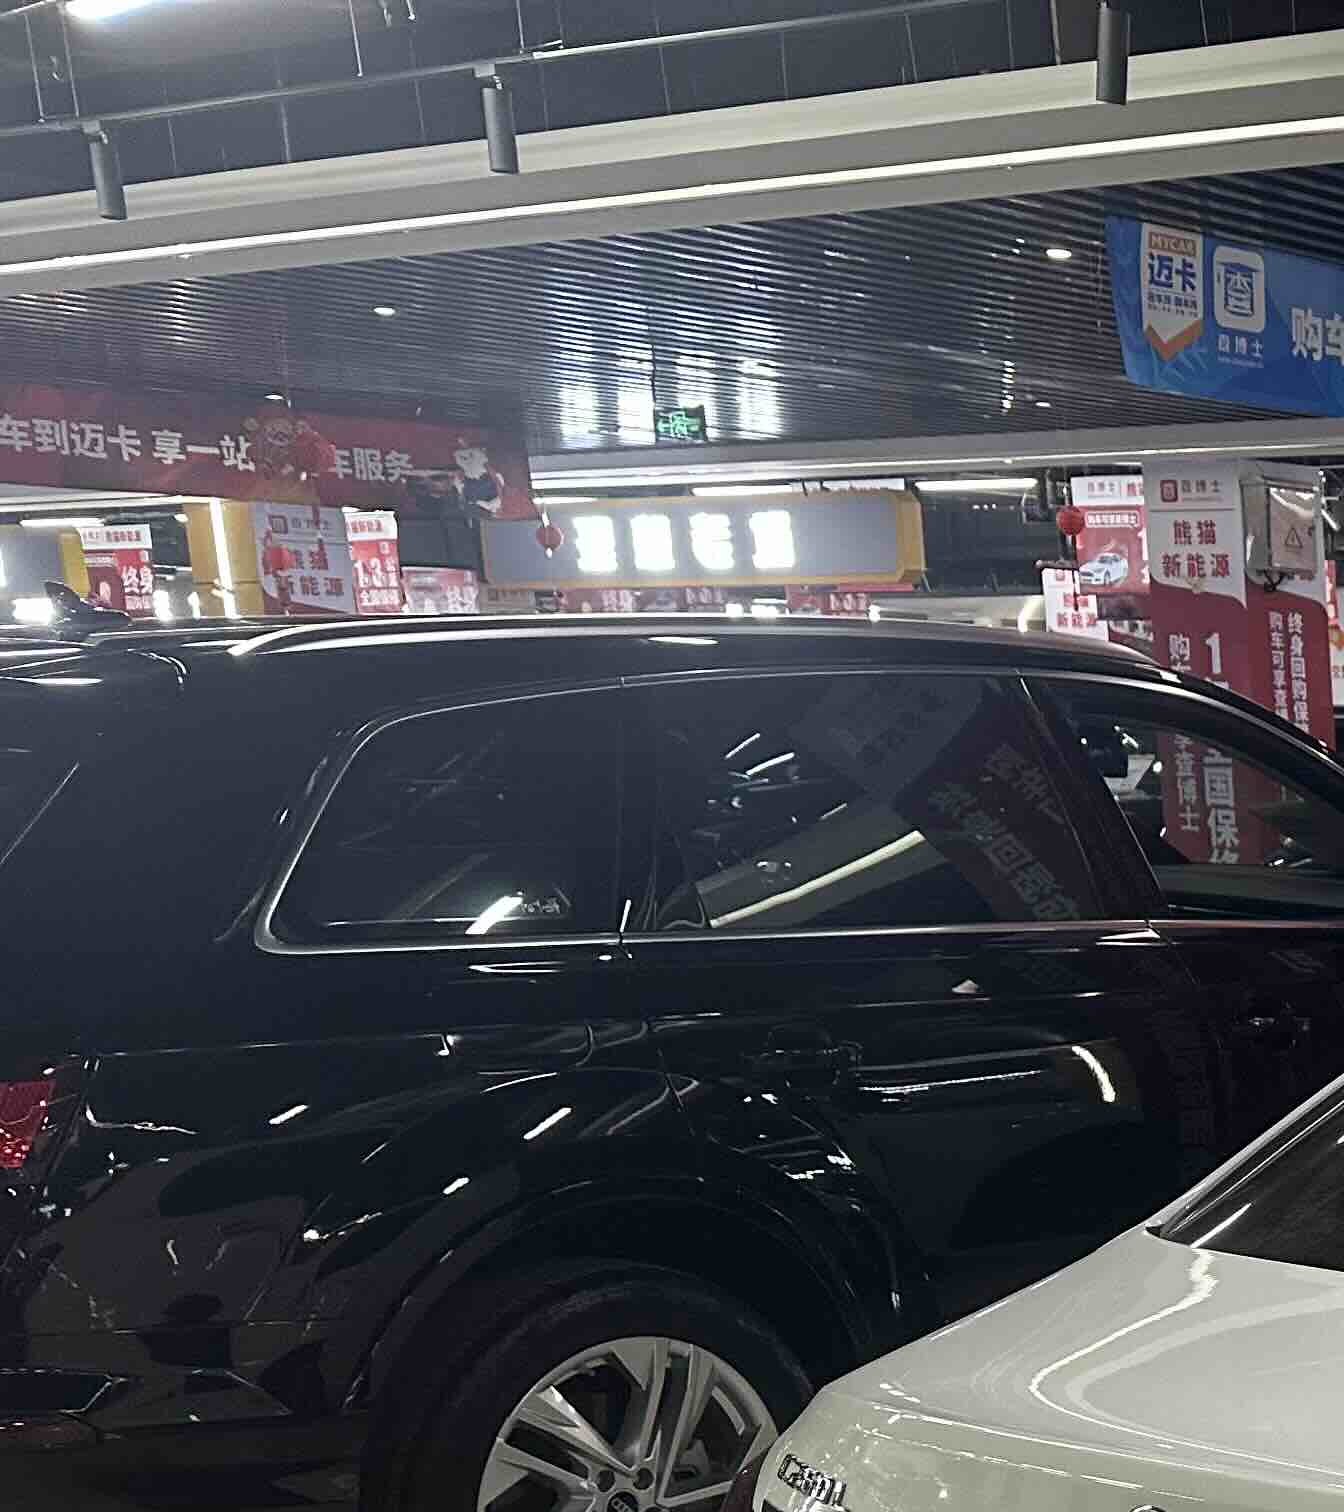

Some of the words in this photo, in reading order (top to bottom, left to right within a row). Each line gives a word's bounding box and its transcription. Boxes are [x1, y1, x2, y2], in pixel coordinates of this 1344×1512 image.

[1148, 253, 1197, 292] 迈卡
[0, 414, 142, 462] 车到迈卡
[1173, 519, 1217, 545] 熊猫
[1161, 551, 1230, 578] 新能源
